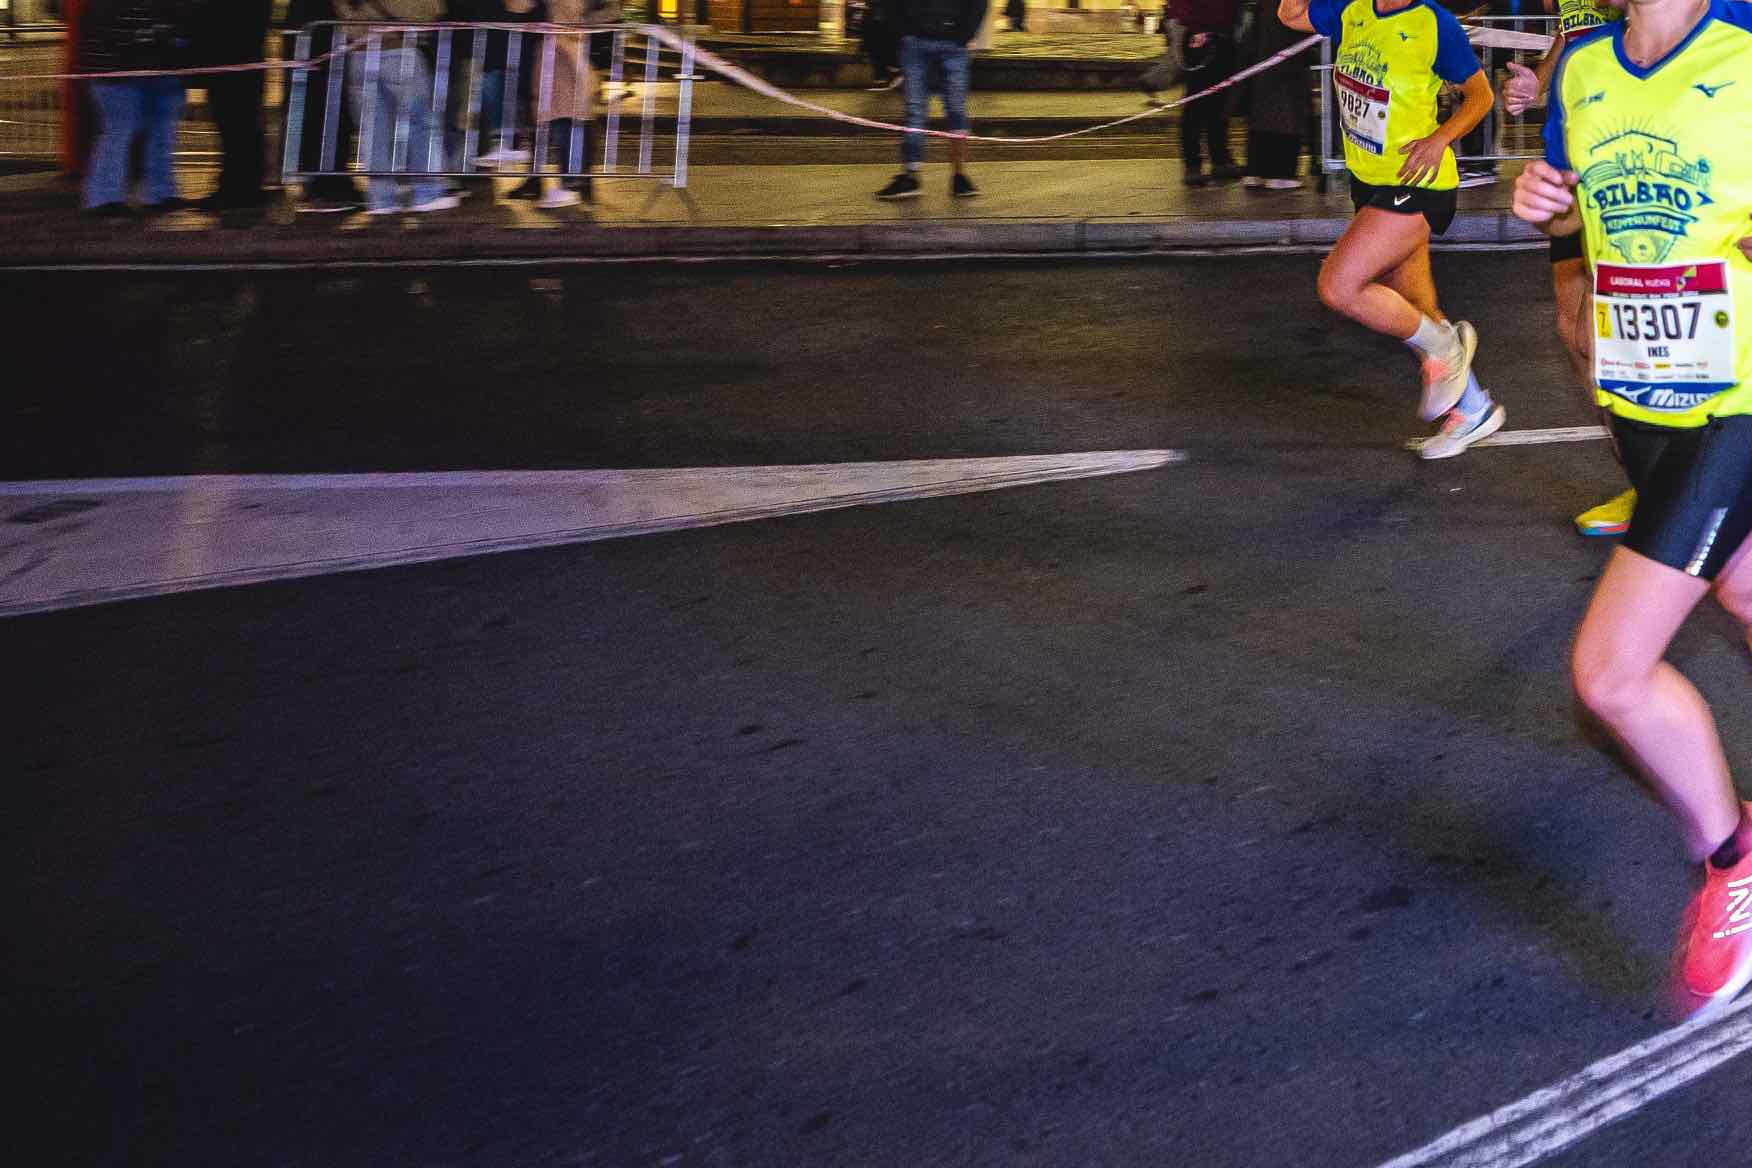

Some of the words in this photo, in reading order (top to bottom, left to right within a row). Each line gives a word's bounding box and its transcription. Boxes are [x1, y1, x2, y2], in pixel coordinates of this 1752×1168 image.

[1593, 181, 1693, 211] BILBAO
[1613, 302, 1702, 341] 13307
[1647, 346, 1670, 358] INES
[1648, 388, 1711, 408] MIZU
